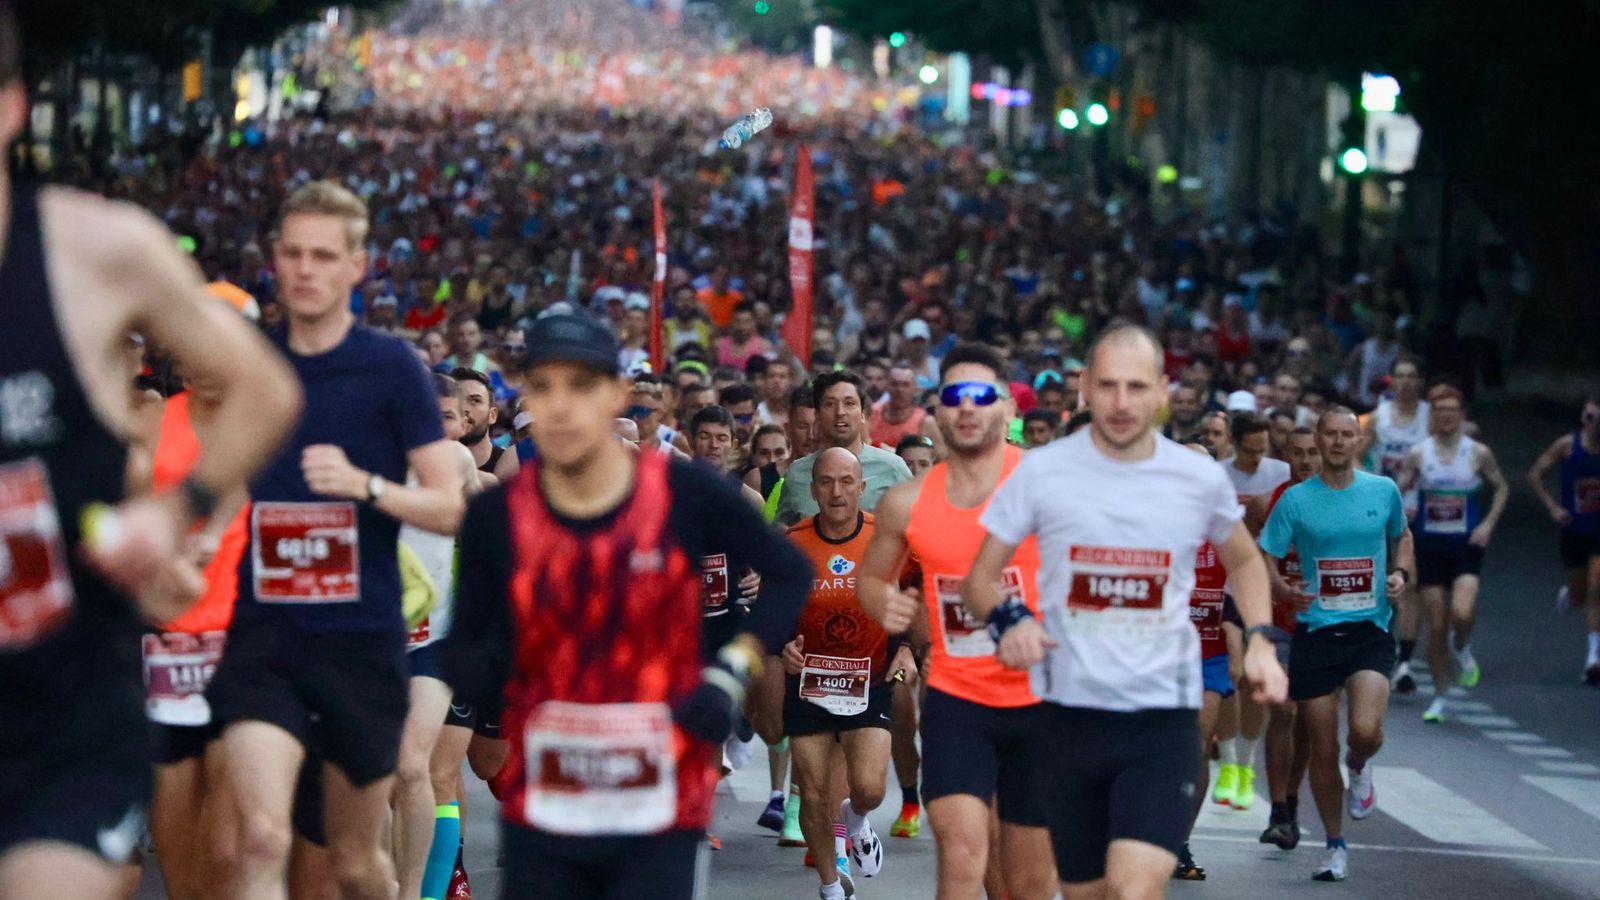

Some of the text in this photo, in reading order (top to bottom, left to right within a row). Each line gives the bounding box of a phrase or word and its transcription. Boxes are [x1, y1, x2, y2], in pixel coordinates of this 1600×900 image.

[1329, 577, 1365, 588] 12514
[1088, 577, 1151, 601] 10482
[821, 659, 866, 670] GENERALI
[816, 676, 855, 689] 14007
